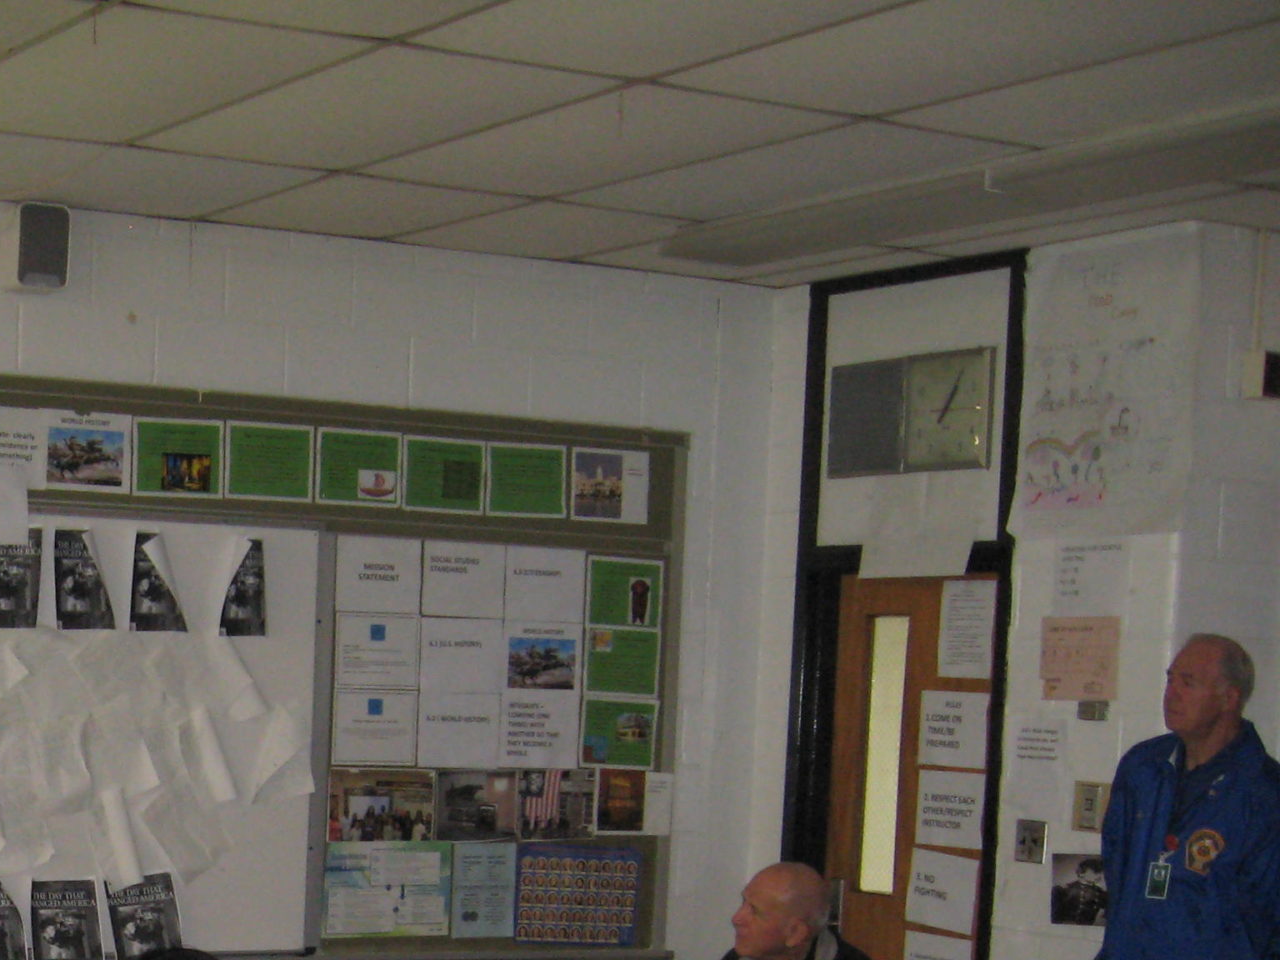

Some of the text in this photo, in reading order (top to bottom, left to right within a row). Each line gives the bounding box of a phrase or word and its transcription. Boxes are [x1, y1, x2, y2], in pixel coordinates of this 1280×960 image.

[364, 563, 394, 571] MISSION
[359, 573, 399, 581] STATEMENT
[931, 794, 957, 803] RESPECT
[958, 797, 975, 805] EACH
[924, 874, 935, 883] NO
[33, 891, 86, 900] THE DAY THAT
[914, 886, 947, 900] FIGHTING
